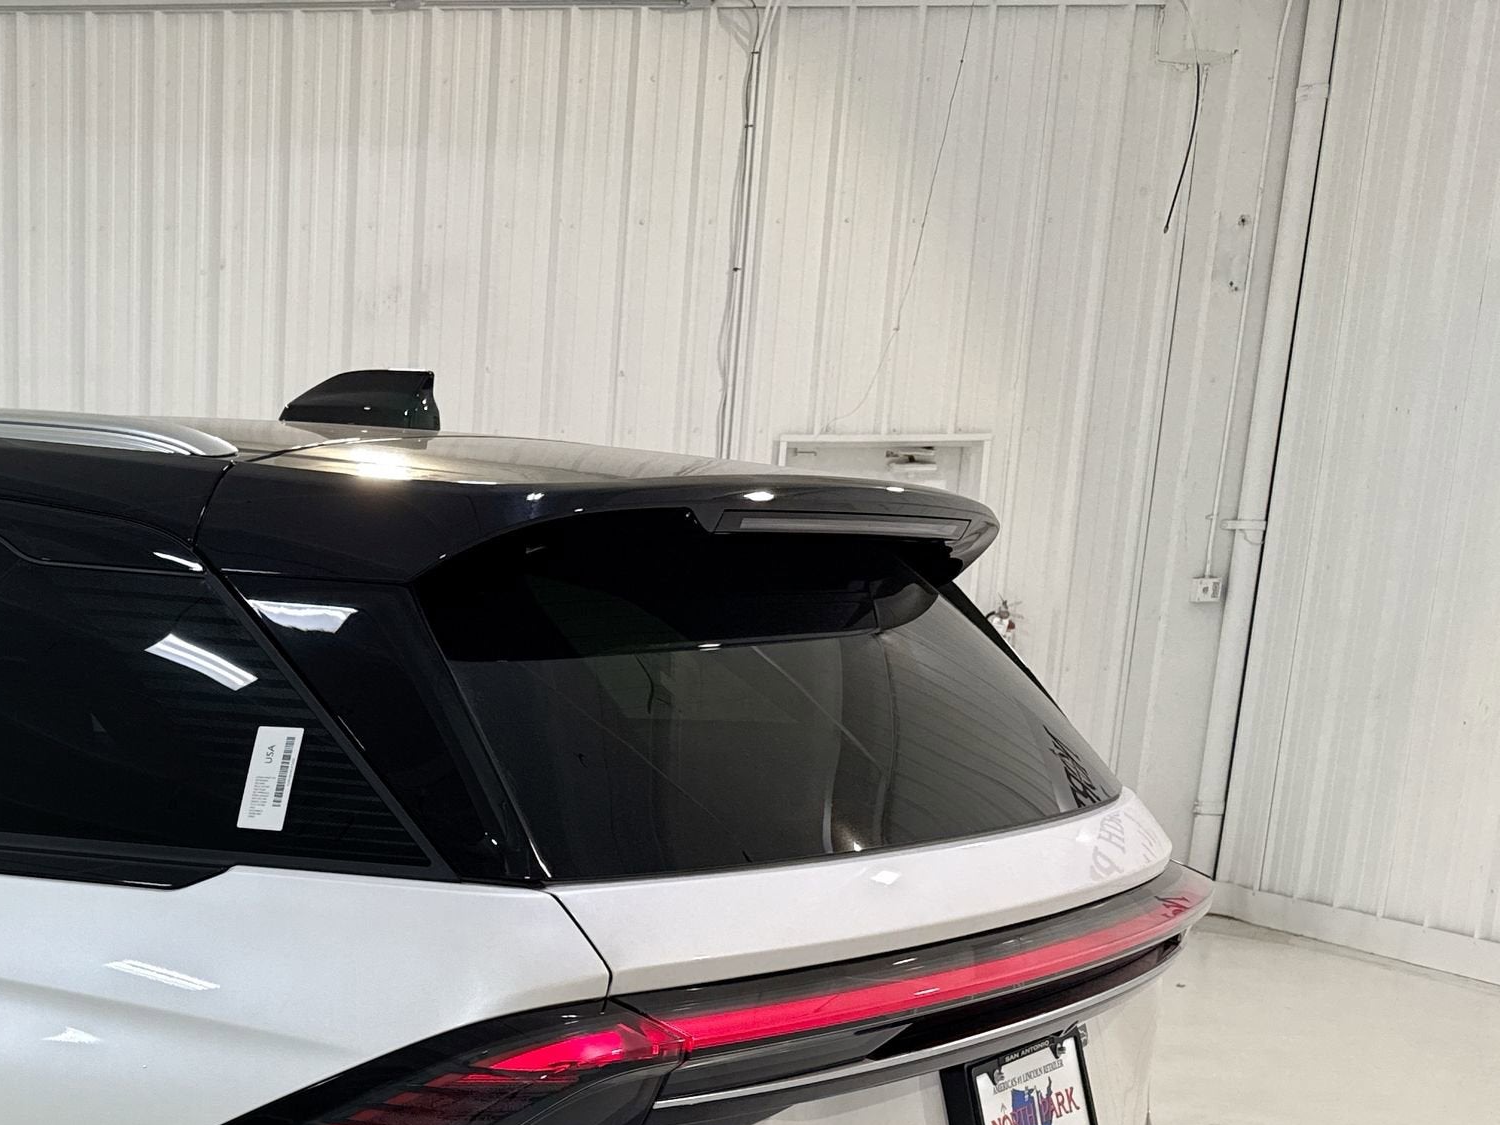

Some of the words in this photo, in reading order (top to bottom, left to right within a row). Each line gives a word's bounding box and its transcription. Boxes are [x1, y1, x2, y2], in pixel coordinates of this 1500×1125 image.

[264, 744, 276, 764] USA
[1005, 1053, 1020, 1062] SAN
[1020, 1040, 1050, 1057] ANTONIO
[1022, 1067, 1043, 1083] LINCOLN
[1039, 1086, 1080, 1122] PARK
